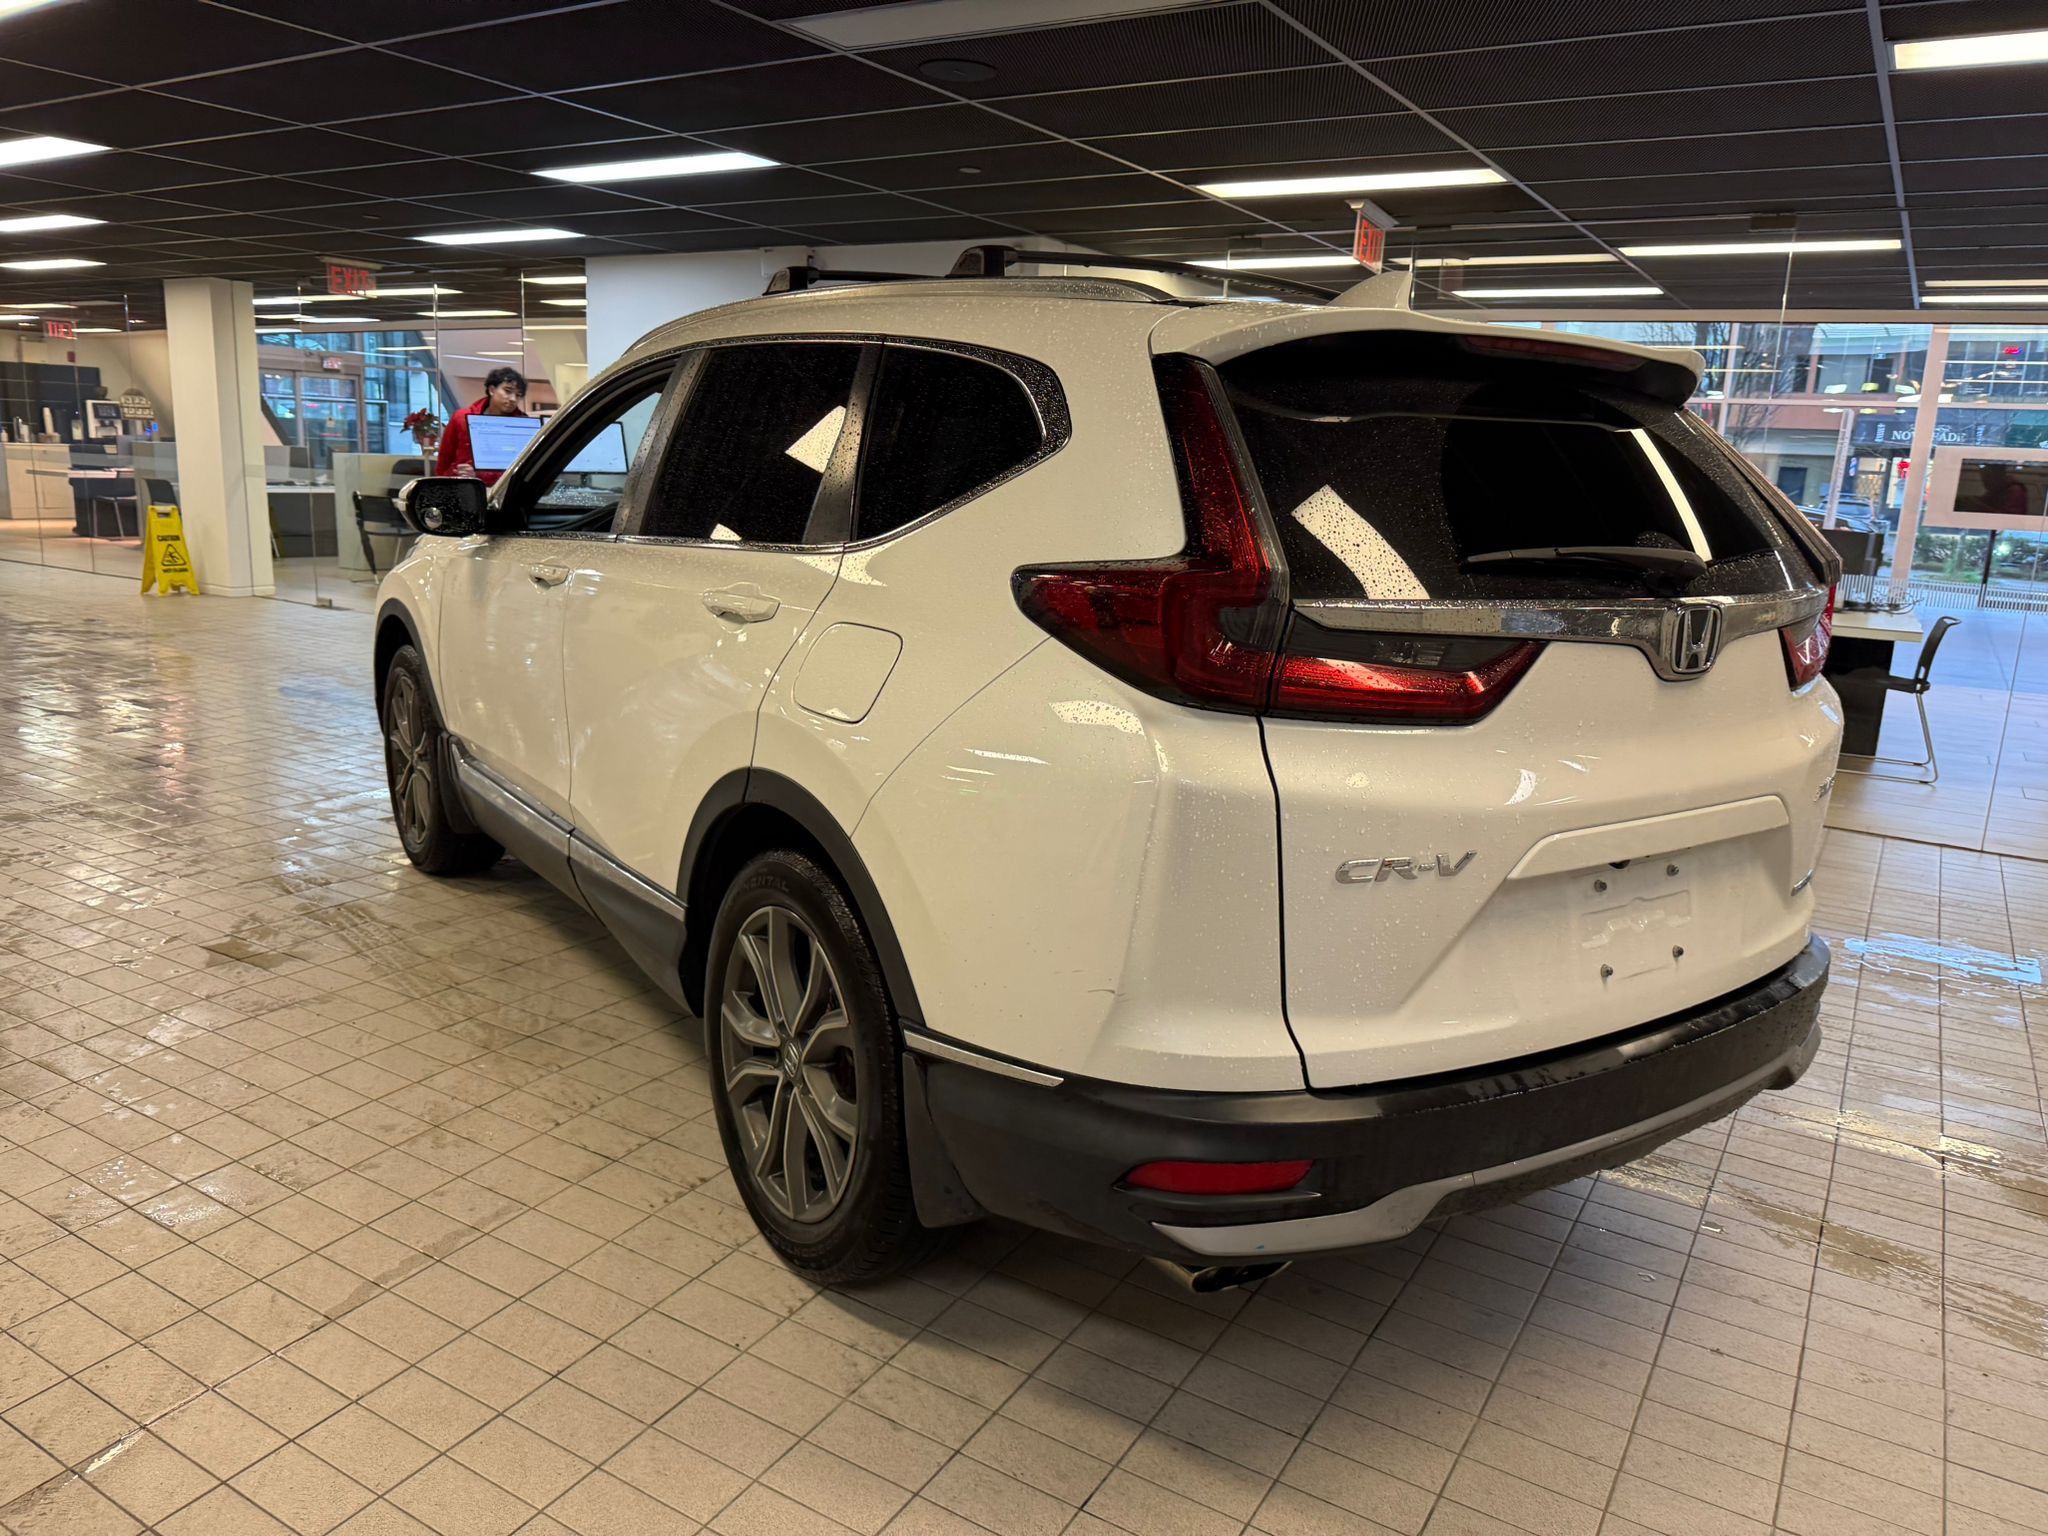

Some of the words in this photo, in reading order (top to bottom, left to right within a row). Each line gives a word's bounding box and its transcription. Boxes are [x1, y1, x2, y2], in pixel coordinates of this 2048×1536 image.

[1360, 219, 1384, 264] EXIT
[330, 265, 370, 295] EXIT
[1335, 850, 1477, 884] CR-V
